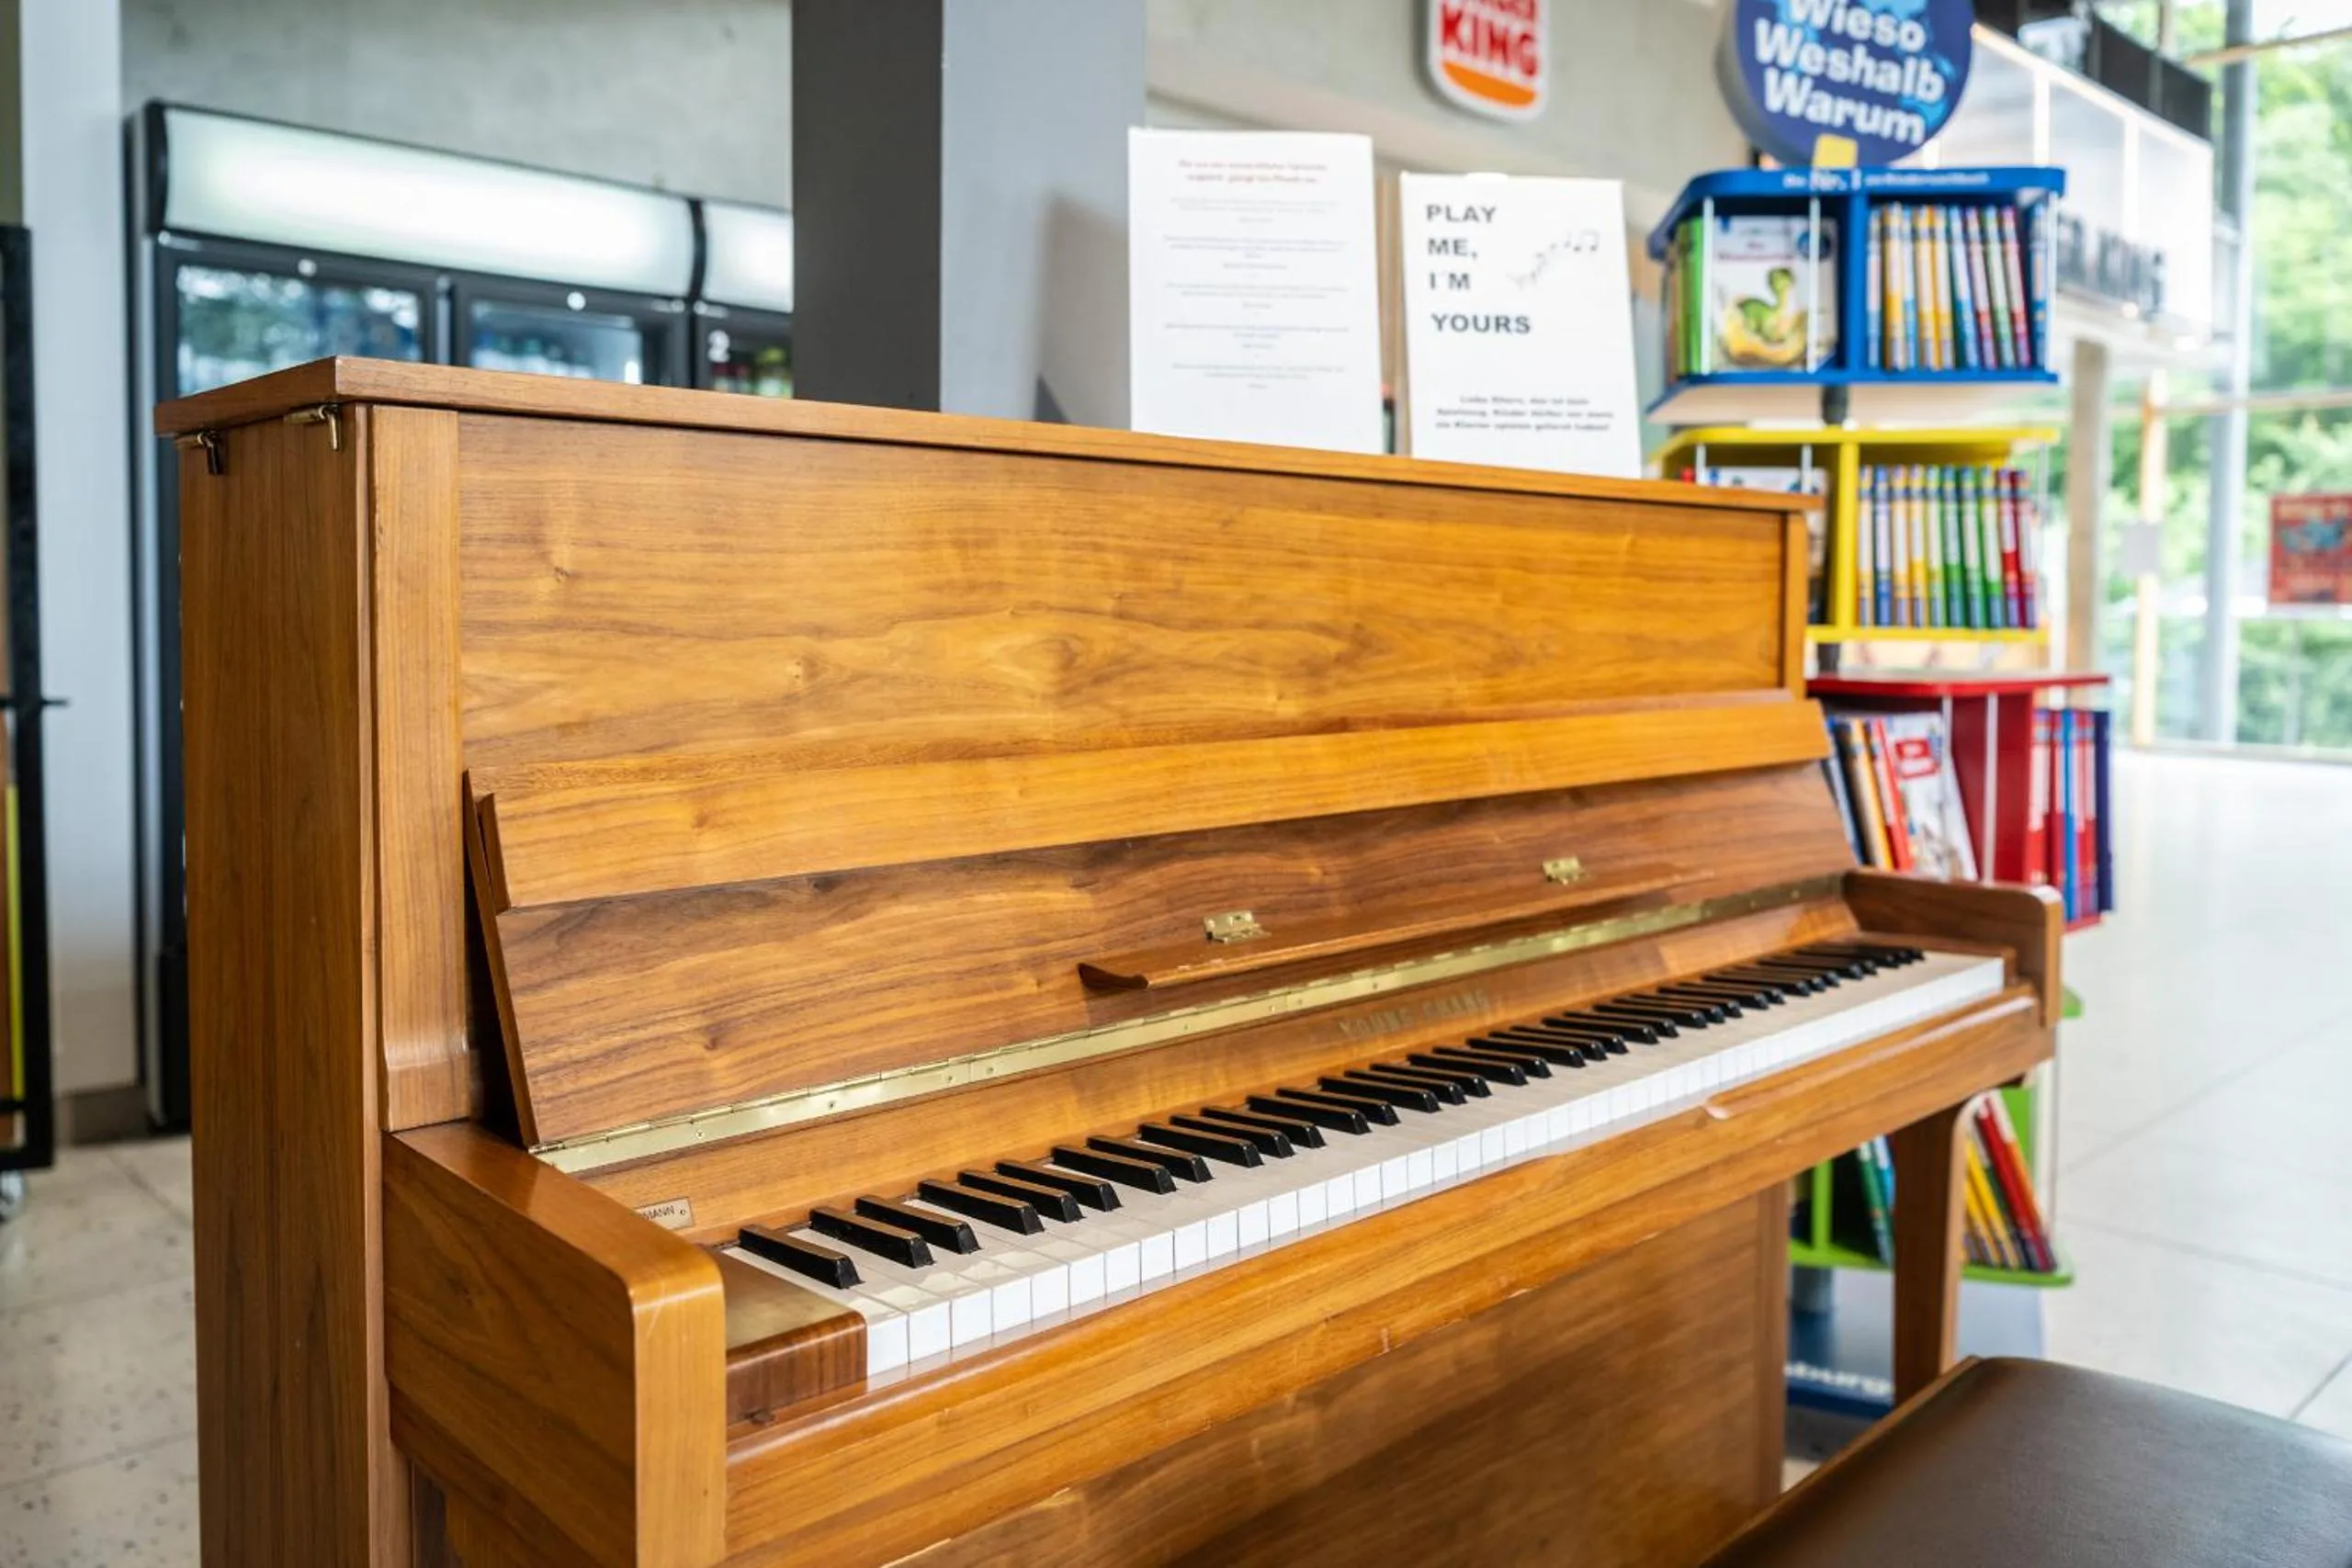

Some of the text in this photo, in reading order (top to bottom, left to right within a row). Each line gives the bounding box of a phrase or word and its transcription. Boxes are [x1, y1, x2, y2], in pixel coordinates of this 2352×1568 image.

[1442, 2, 1536, 77] KING
[1790, 0, 1927, 52] Wieso
[1755, 17, 1945, 104] Weshalb
[1764, 66, 1926, 146] Warum
[1426, 204, 1497, 223] PLAY
[1428, 238, 1477, 261] ME,
[1430, 312, 1531, 334] YOURS
